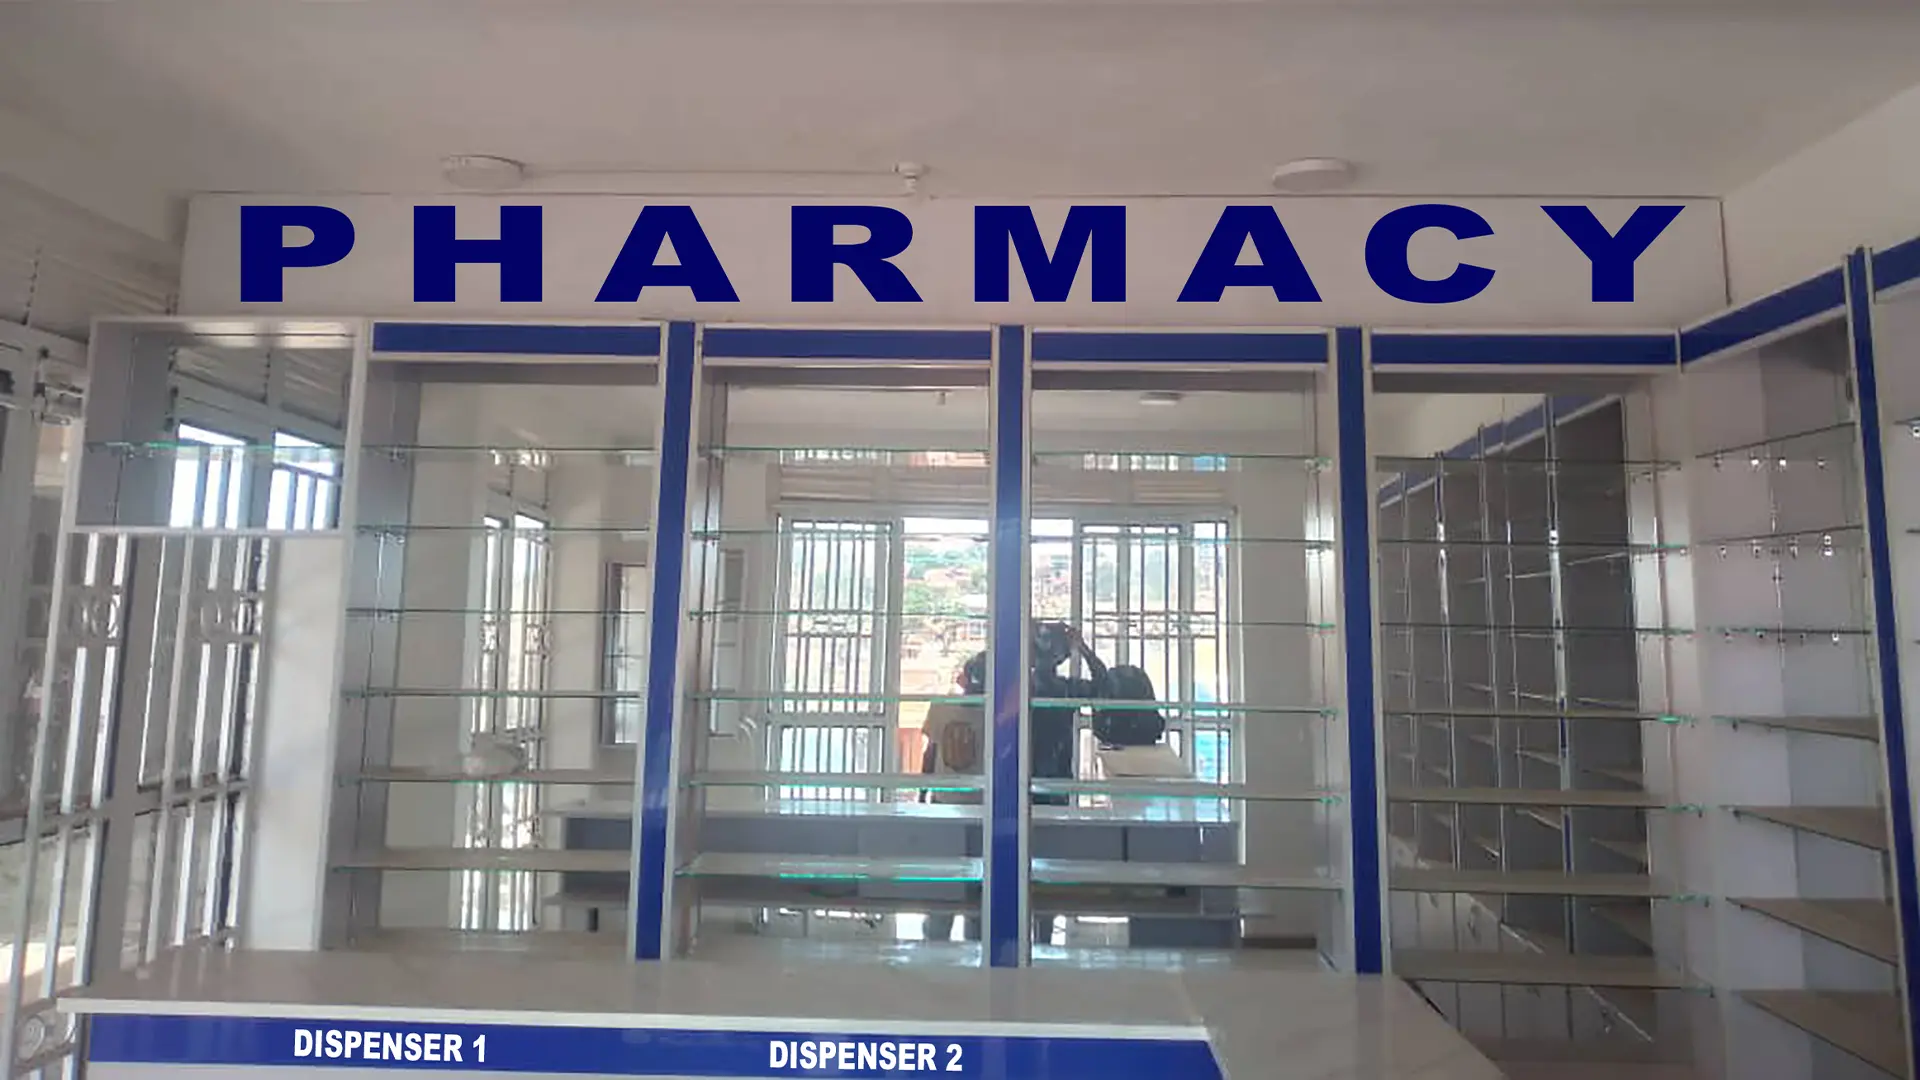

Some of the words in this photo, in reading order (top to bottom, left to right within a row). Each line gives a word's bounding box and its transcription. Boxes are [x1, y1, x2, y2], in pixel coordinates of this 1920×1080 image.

[240, 204, 1684, 304] PHARMACY
[293, 1028, 463, 1062] DISPENSER
[472, 1033, 487, 1063] 1
[768, 1039, 937, 1072] DISPENSER
[945, 1042, 964, 1072] 2
